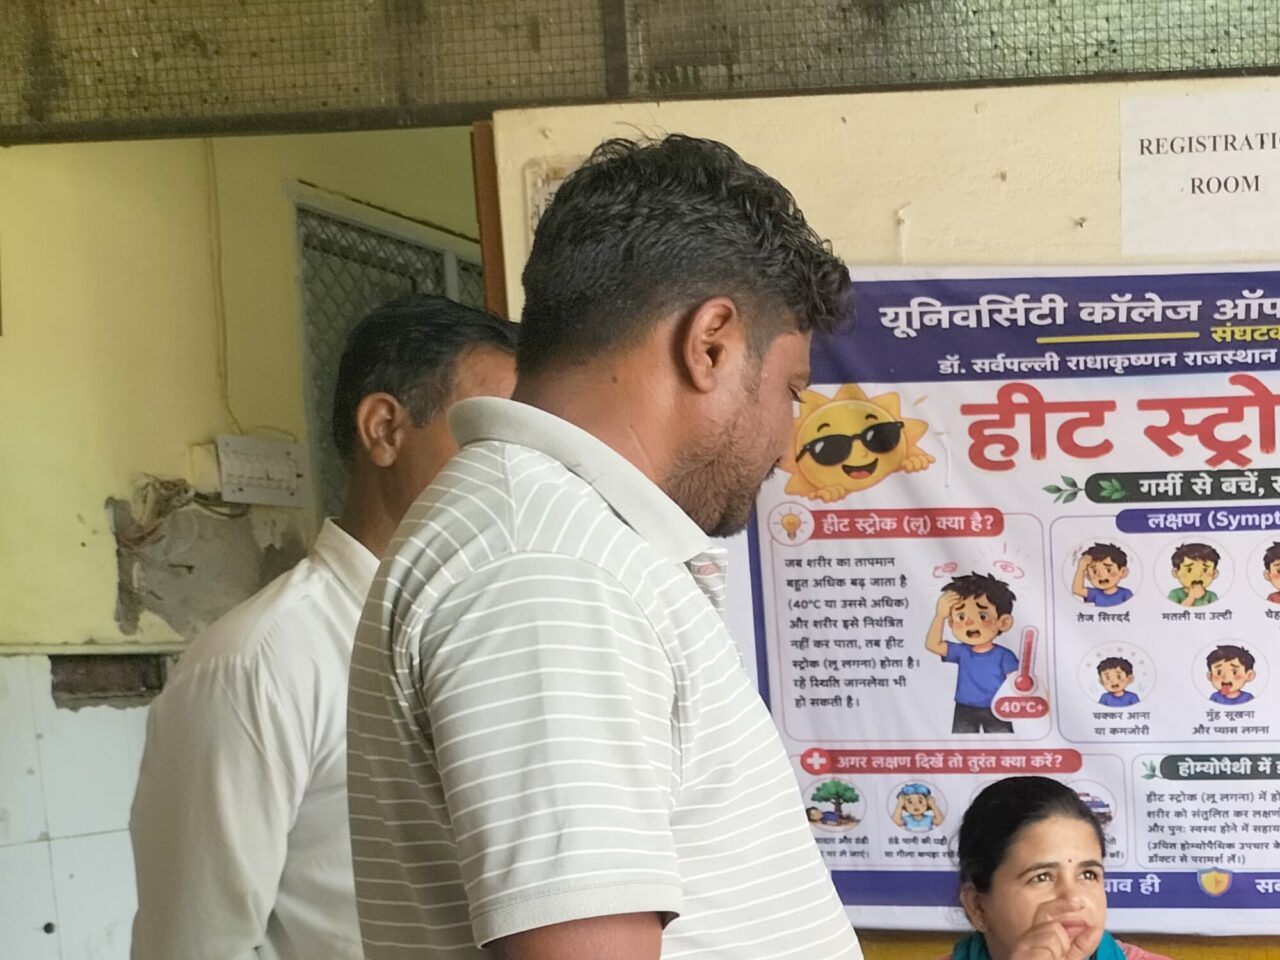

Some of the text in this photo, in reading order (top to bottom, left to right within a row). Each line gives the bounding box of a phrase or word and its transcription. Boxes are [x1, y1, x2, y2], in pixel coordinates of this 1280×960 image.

[1190, 175, 1261, 194] ROOM
[879, 294, 1068, 338] यूनिवर्सिटी
[1078, 292, 1202, 324] कॉलेज
[938, 354, 966, 375] डॉ.
[972, 352, 1060, 374] सर्वपल्ली
[1067, 351, 1177, 376] राधाकृष्णन
[1184, 347, 1277, 367] राजस्थान
[960, 382, 1117, 472] हीट
[1139, 473, 1184, 496] गर्मी
[1191, 473, 1212, 495] से
[1221, 471, 1265, 496] बचें,
[822, 512, 994, 535] हीट स्ट्रोक (लू) क्या है?
[1148, 513, 1202, 530] लक्षण
[784, 556, 895, 568] जब शरीर का तापमान
[786, 576, 896, 592] बहुत अधिक जाता
[824, 596, 909, 610] या उससे अधिक)
[789, 617, 808, 629] और
[813, 616, 838, 628] शरीर
[842, 616, 859, 630] इसे
[1077, 612, 1094, 622] तेज
[1194, 612, 1206, 620] या
[790, 636, 904, 650] नहीं कर तब हीट
[792, 657, 820, 670] स्ट्रोक
[880, 656, 903, 669] होता
[844, 676, 888, 688] जानलेवा
[893, 675, 906, 688] भी
[810, 696, 842, 706] सकती
[1126, 712, 1150, 720] आना
[836, 752, 1062, 772] अगर लक्षण दिखें तो तुरंत क्या करें?
[1178, 756, 1252, 776] होम्योपैथी
[1258, 756, 1272, 775] में
[1146, 790, 1165, 802] हीट
[1138, 874, 1162, 895] ही
